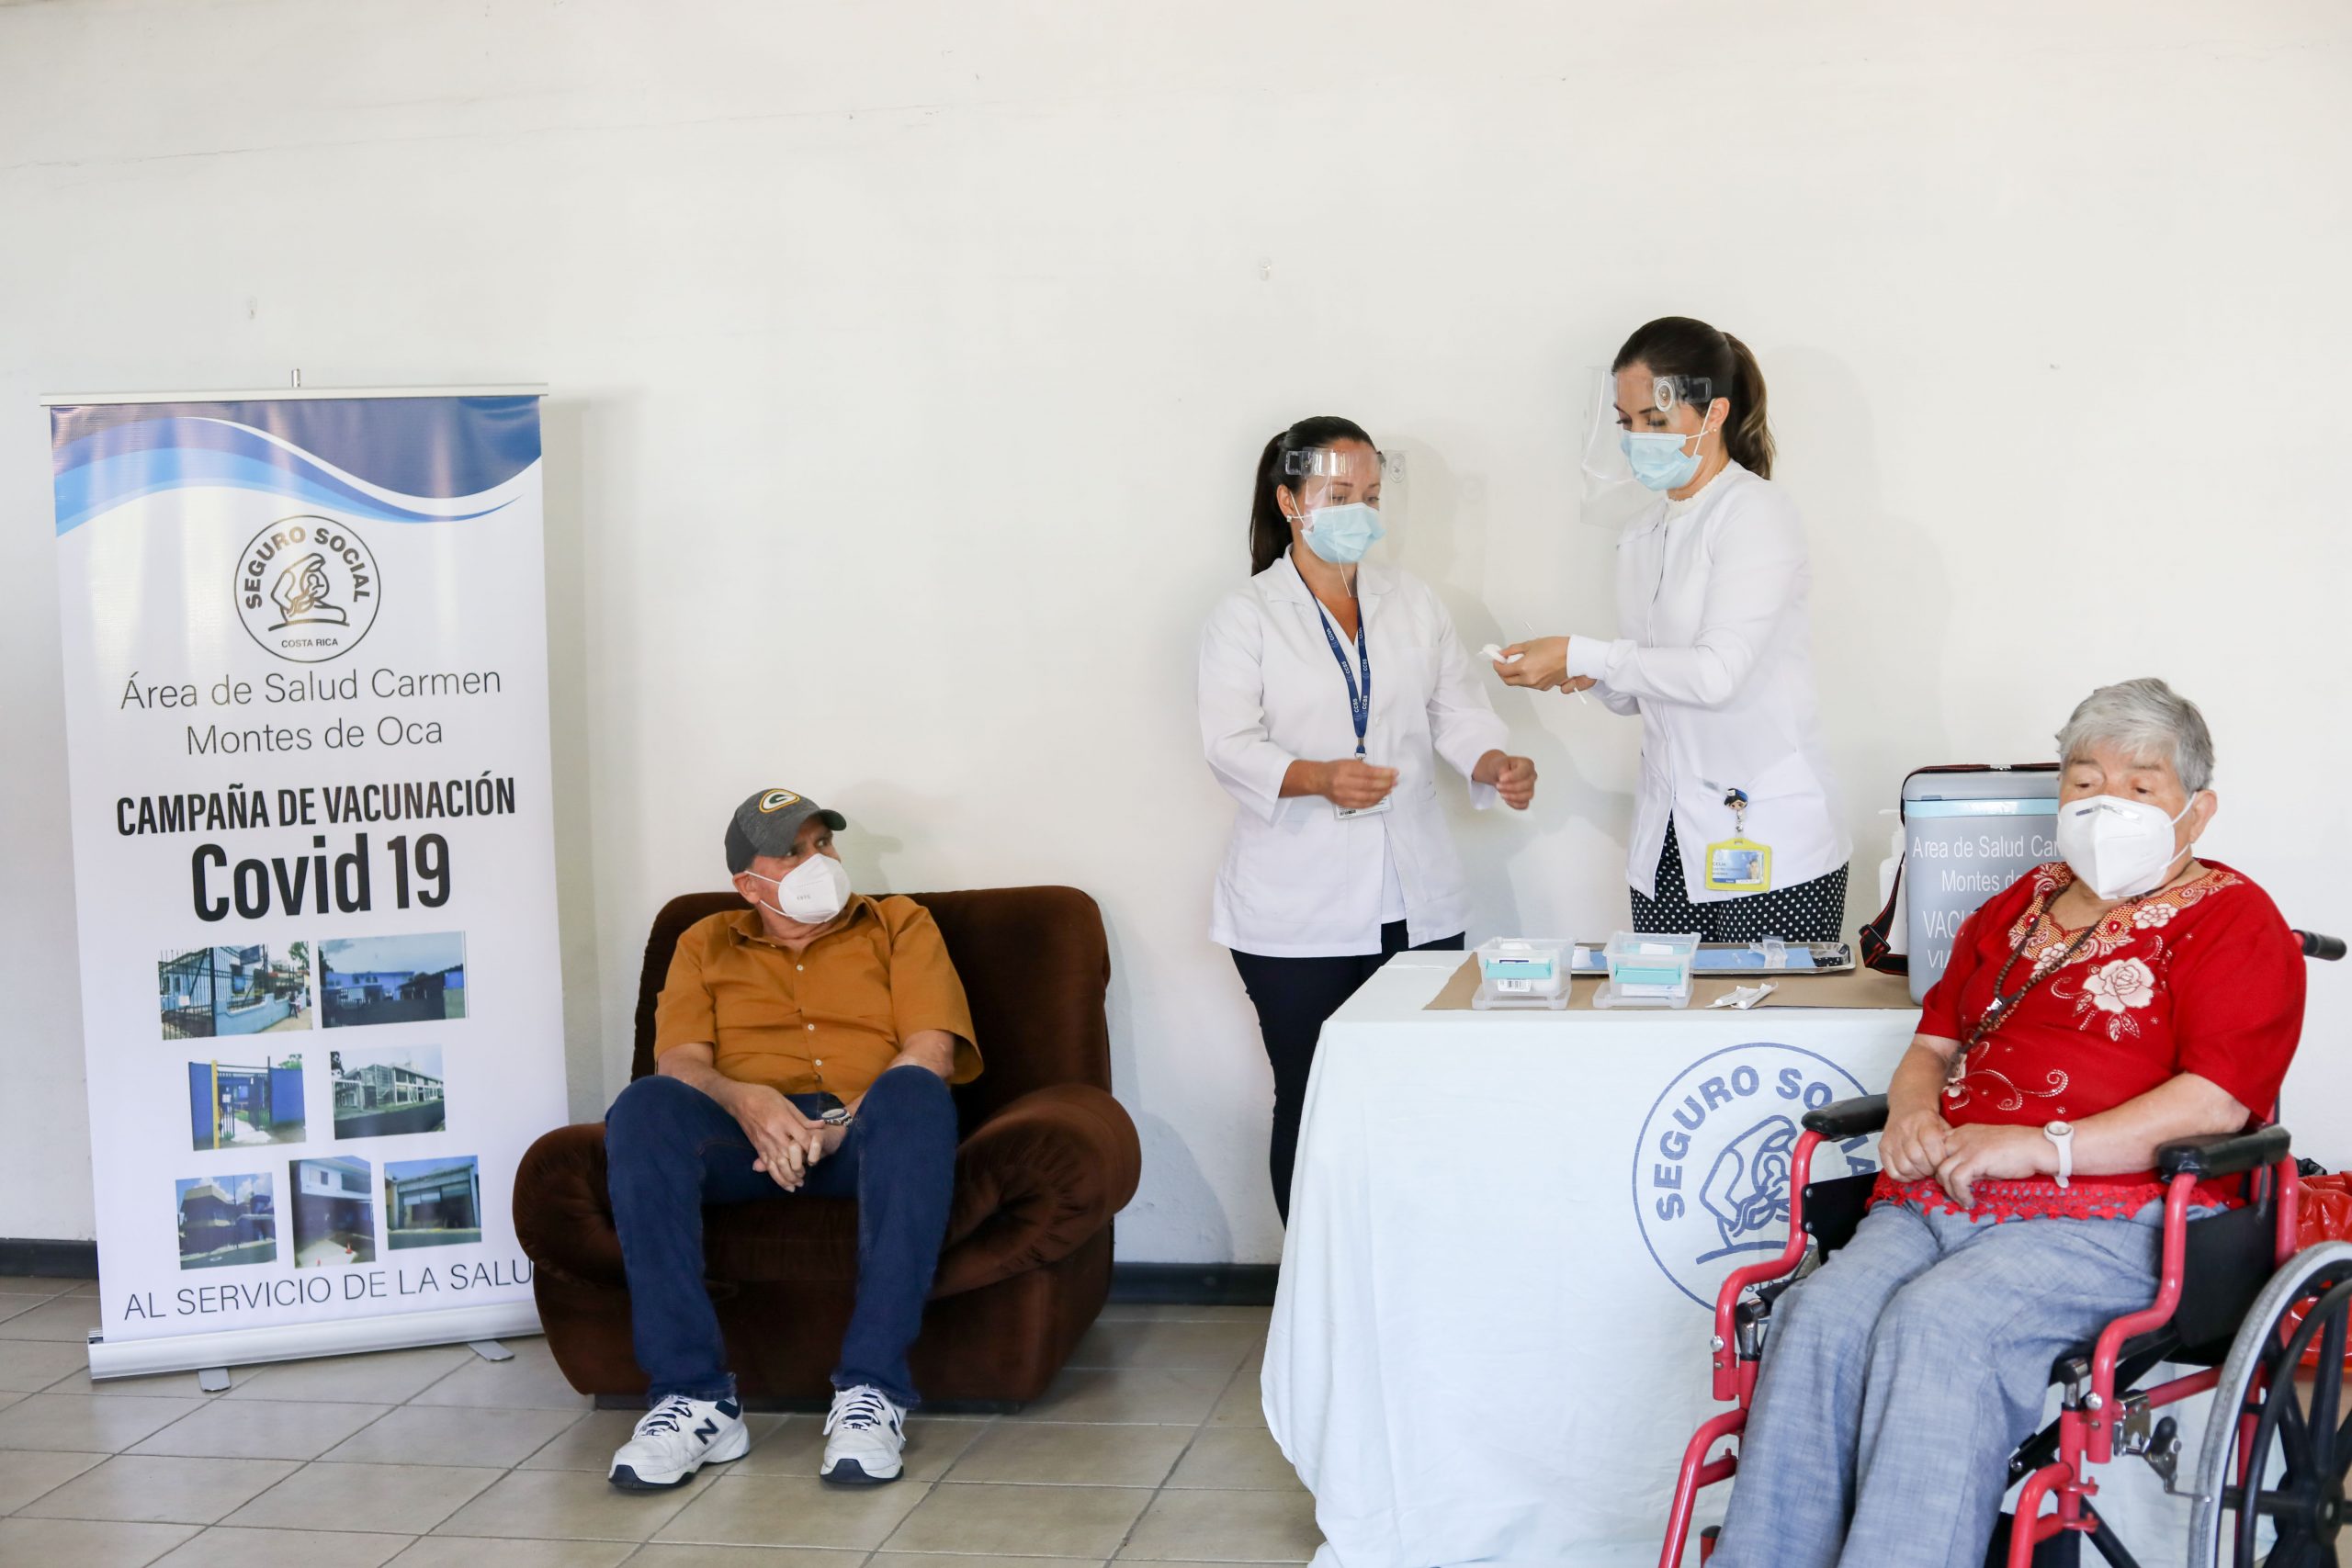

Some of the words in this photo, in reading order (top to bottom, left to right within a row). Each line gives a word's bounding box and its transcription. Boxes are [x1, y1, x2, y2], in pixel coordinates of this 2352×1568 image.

[244, 526, 306, 610] SEGURO
[314, 527, 370, 603] SOCIAL
[281, 639, 313, 649] COSTA
[316, 638, 339, 648] RICA
[120, 671, 198, 710] Área
[211, 674, 253, 705] de
[265, 669, 357, 704] Salud
[371, 669, 501, 698] Carmen
[187, 725, 312, 755] Montes
[324, 717, 365, 750] de
[377, 716, 443, 746] Oca
[118, 784, 270, 836] CAMPAÑA
[278, 788, 317, 827] DE
[322, 771, 515, 824] VACUNACIÓN
[1912, 836, 1949, 858] Area
[1953, 836, 1973, 858] de
[1978, 835, 2024, 857] Salud
[2030, 834, 2059, 857] Car
[190, 833, 371, 922] Covid
[387, 833, 451, 909] 19
[1941, 870, 2000, 892] Montes
[2005, 869, 2024, 889] d
[1922, 909, 1965, 939] VAC
[1654, 1065, 1759, 1222] SEGURO
[1775, 1067, 1877, 1177] SOIA
[124, 1292, 166, 1321] AL
[177, 1277, 331, 1315] SERVICIO
[345, 1272, 387, 1301] DE
[399, 1268, 439, 1295] LA
[450, 1259, 533, 1291] SALU
[694, 1417, 720, 1445] N
